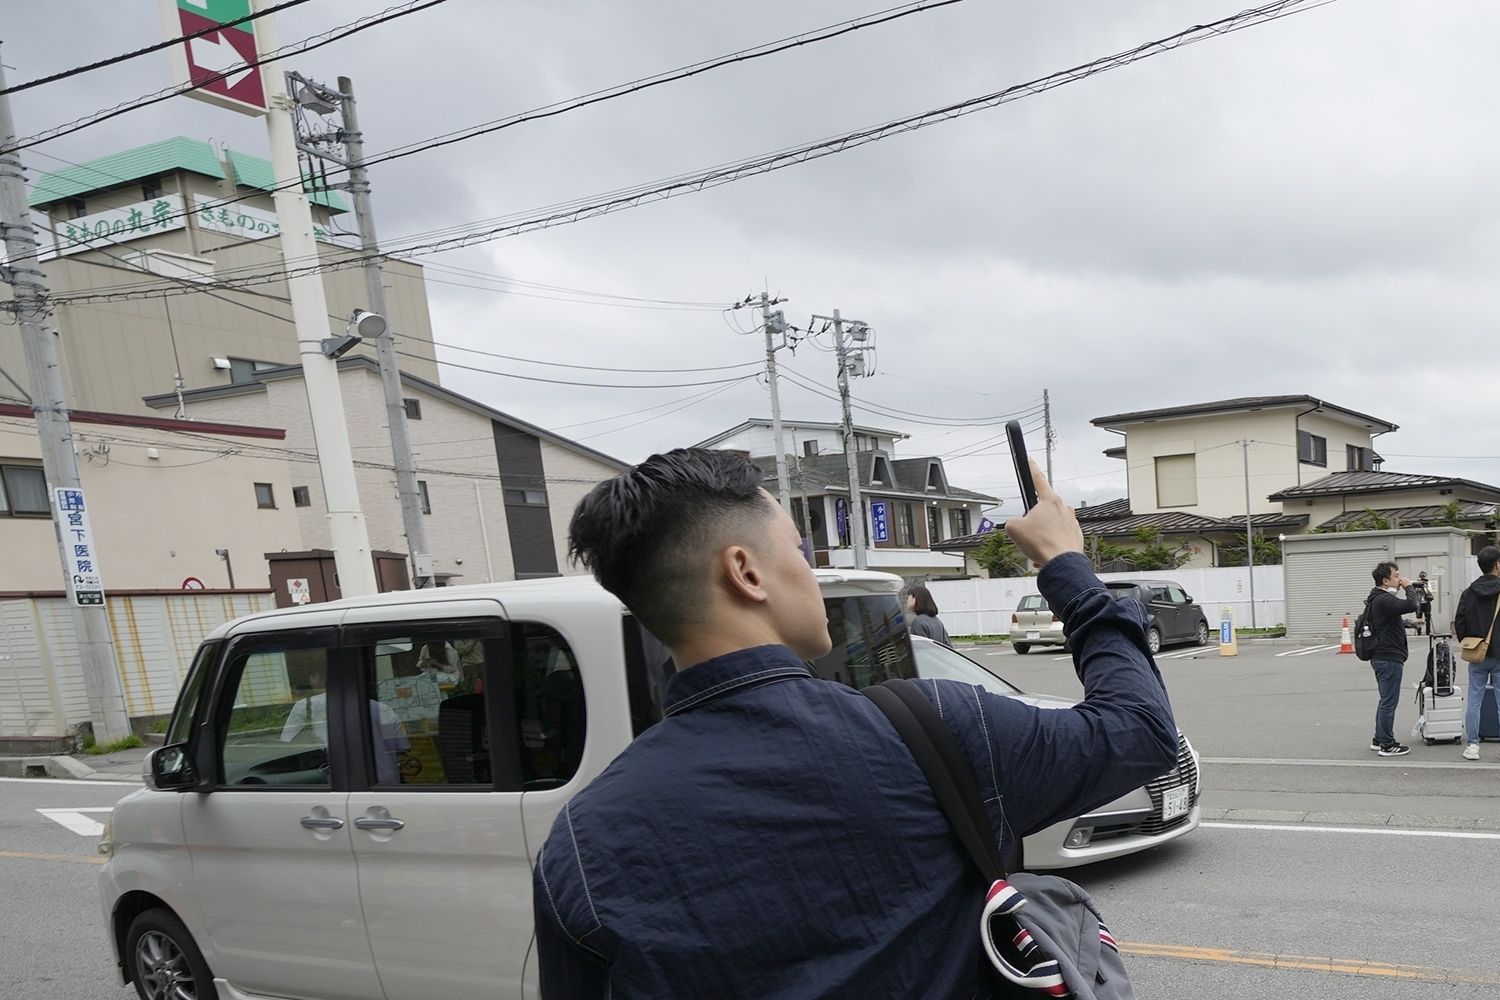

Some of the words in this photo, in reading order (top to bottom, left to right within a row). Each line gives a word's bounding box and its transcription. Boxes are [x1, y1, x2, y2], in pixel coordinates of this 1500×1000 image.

[66, 200, 174, 246] きものの丸宗
[68, 511, 93, 573] 宮下医院
